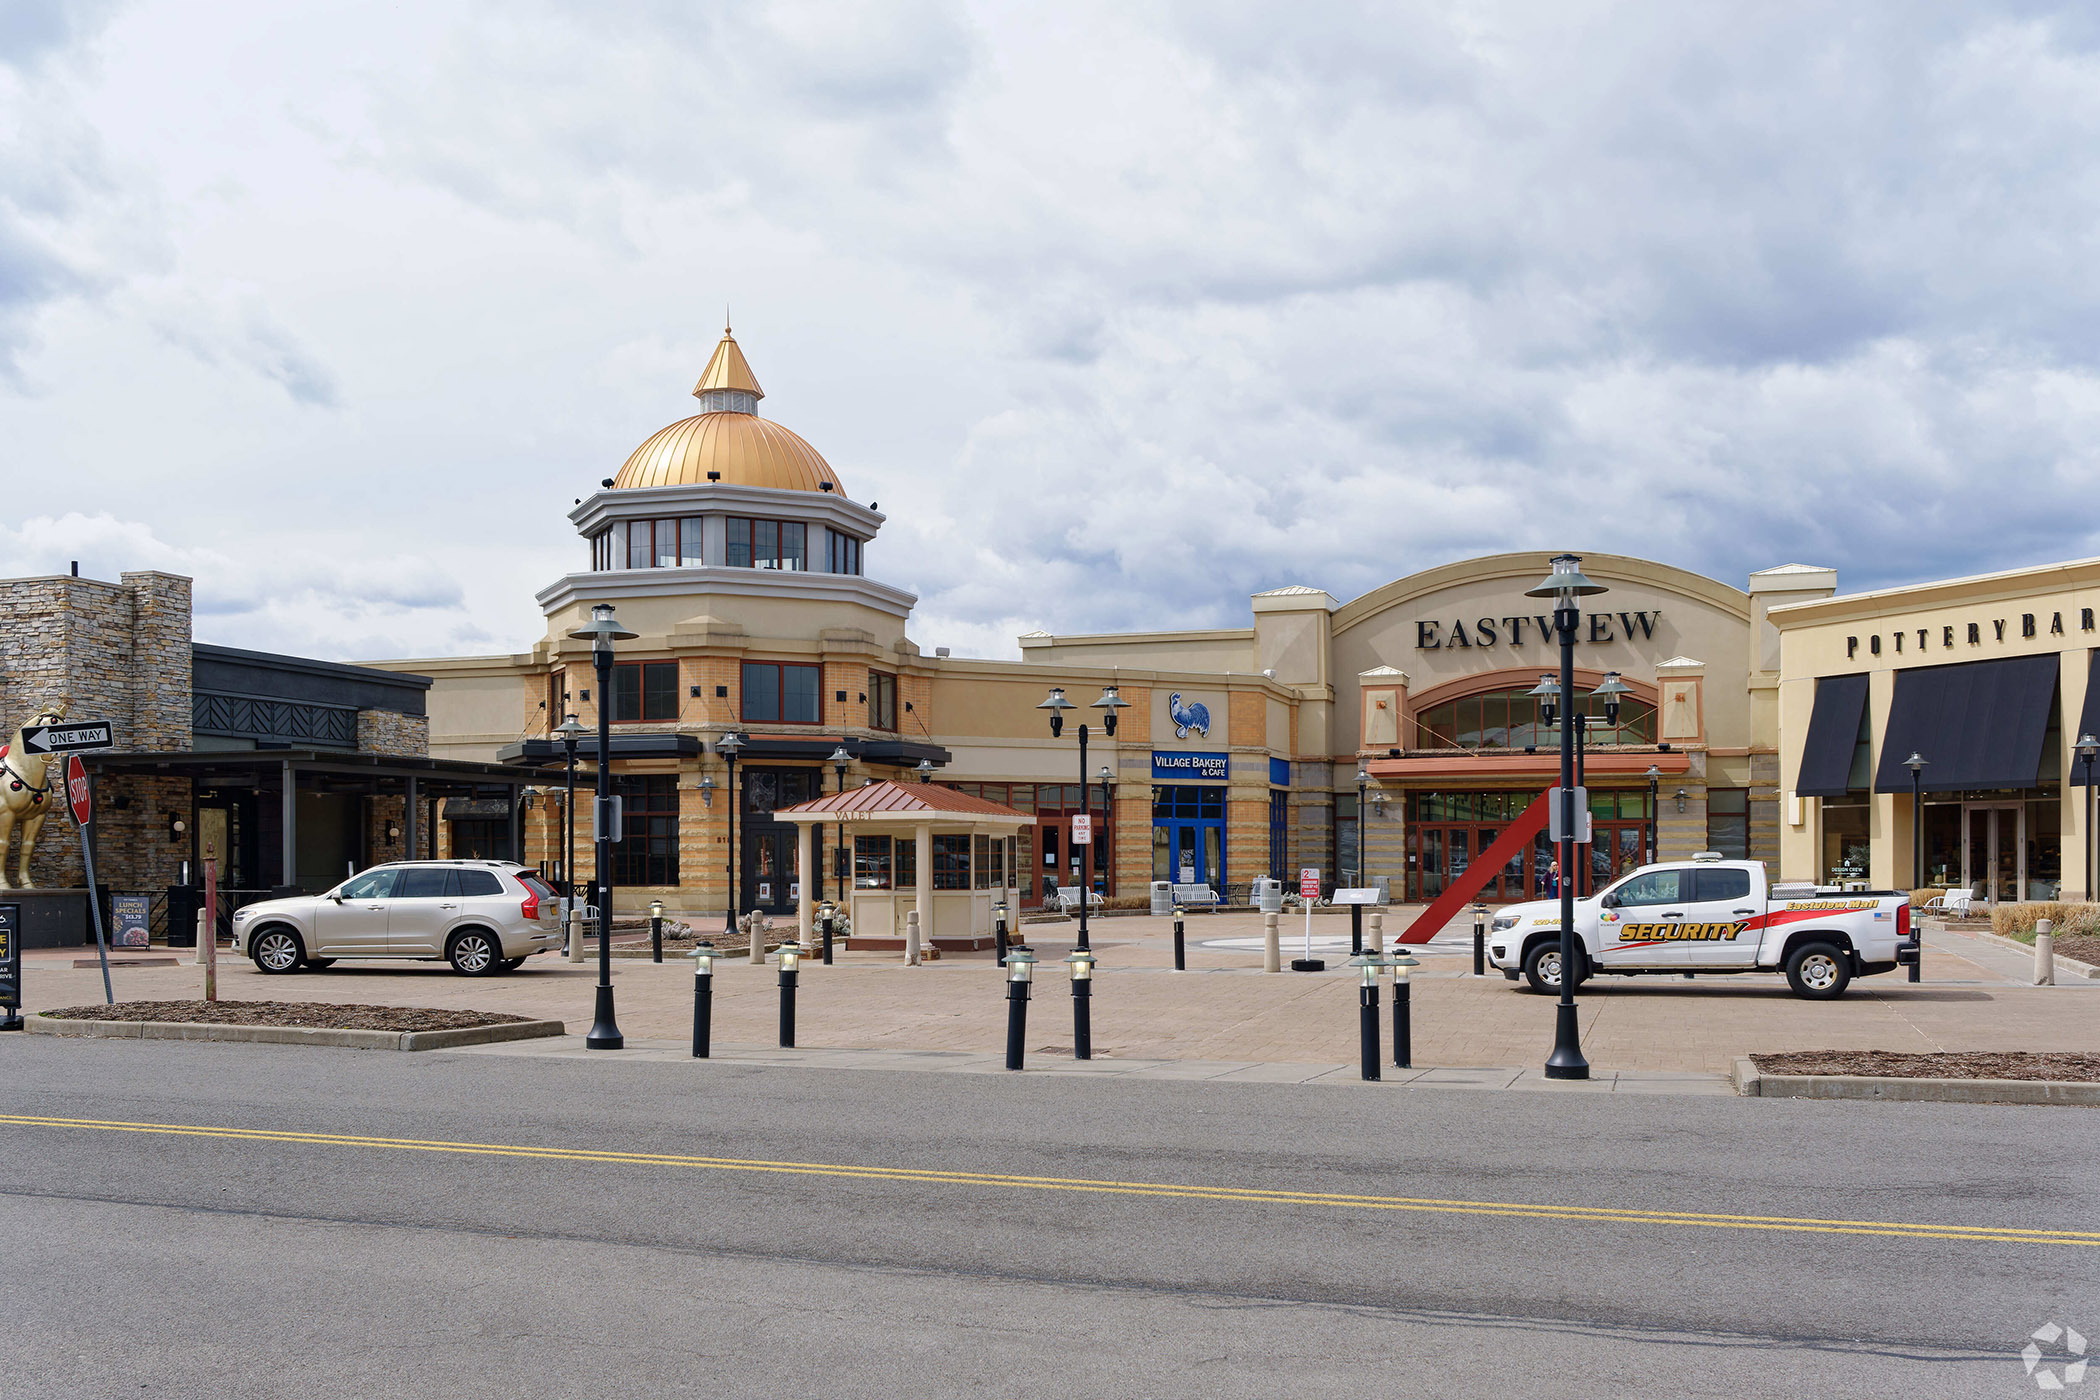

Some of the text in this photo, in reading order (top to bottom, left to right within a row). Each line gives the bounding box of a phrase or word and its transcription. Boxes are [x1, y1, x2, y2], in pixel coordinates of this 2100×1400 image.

[1414, 610, 1662, 649] EASTVEW
[49, 729, 102, 744] ONE WAY
[1155, 756, 1227, 768] VILLAGE BAKERY
[1201, 768, 1208, 776] &
[70, 776, 88, 804] STOP
[833, 810, 874, 820] VALET
[1785, 899, 1880, 911] Eastview Mall
[1619, 922, 1750, 941] SECURITY
